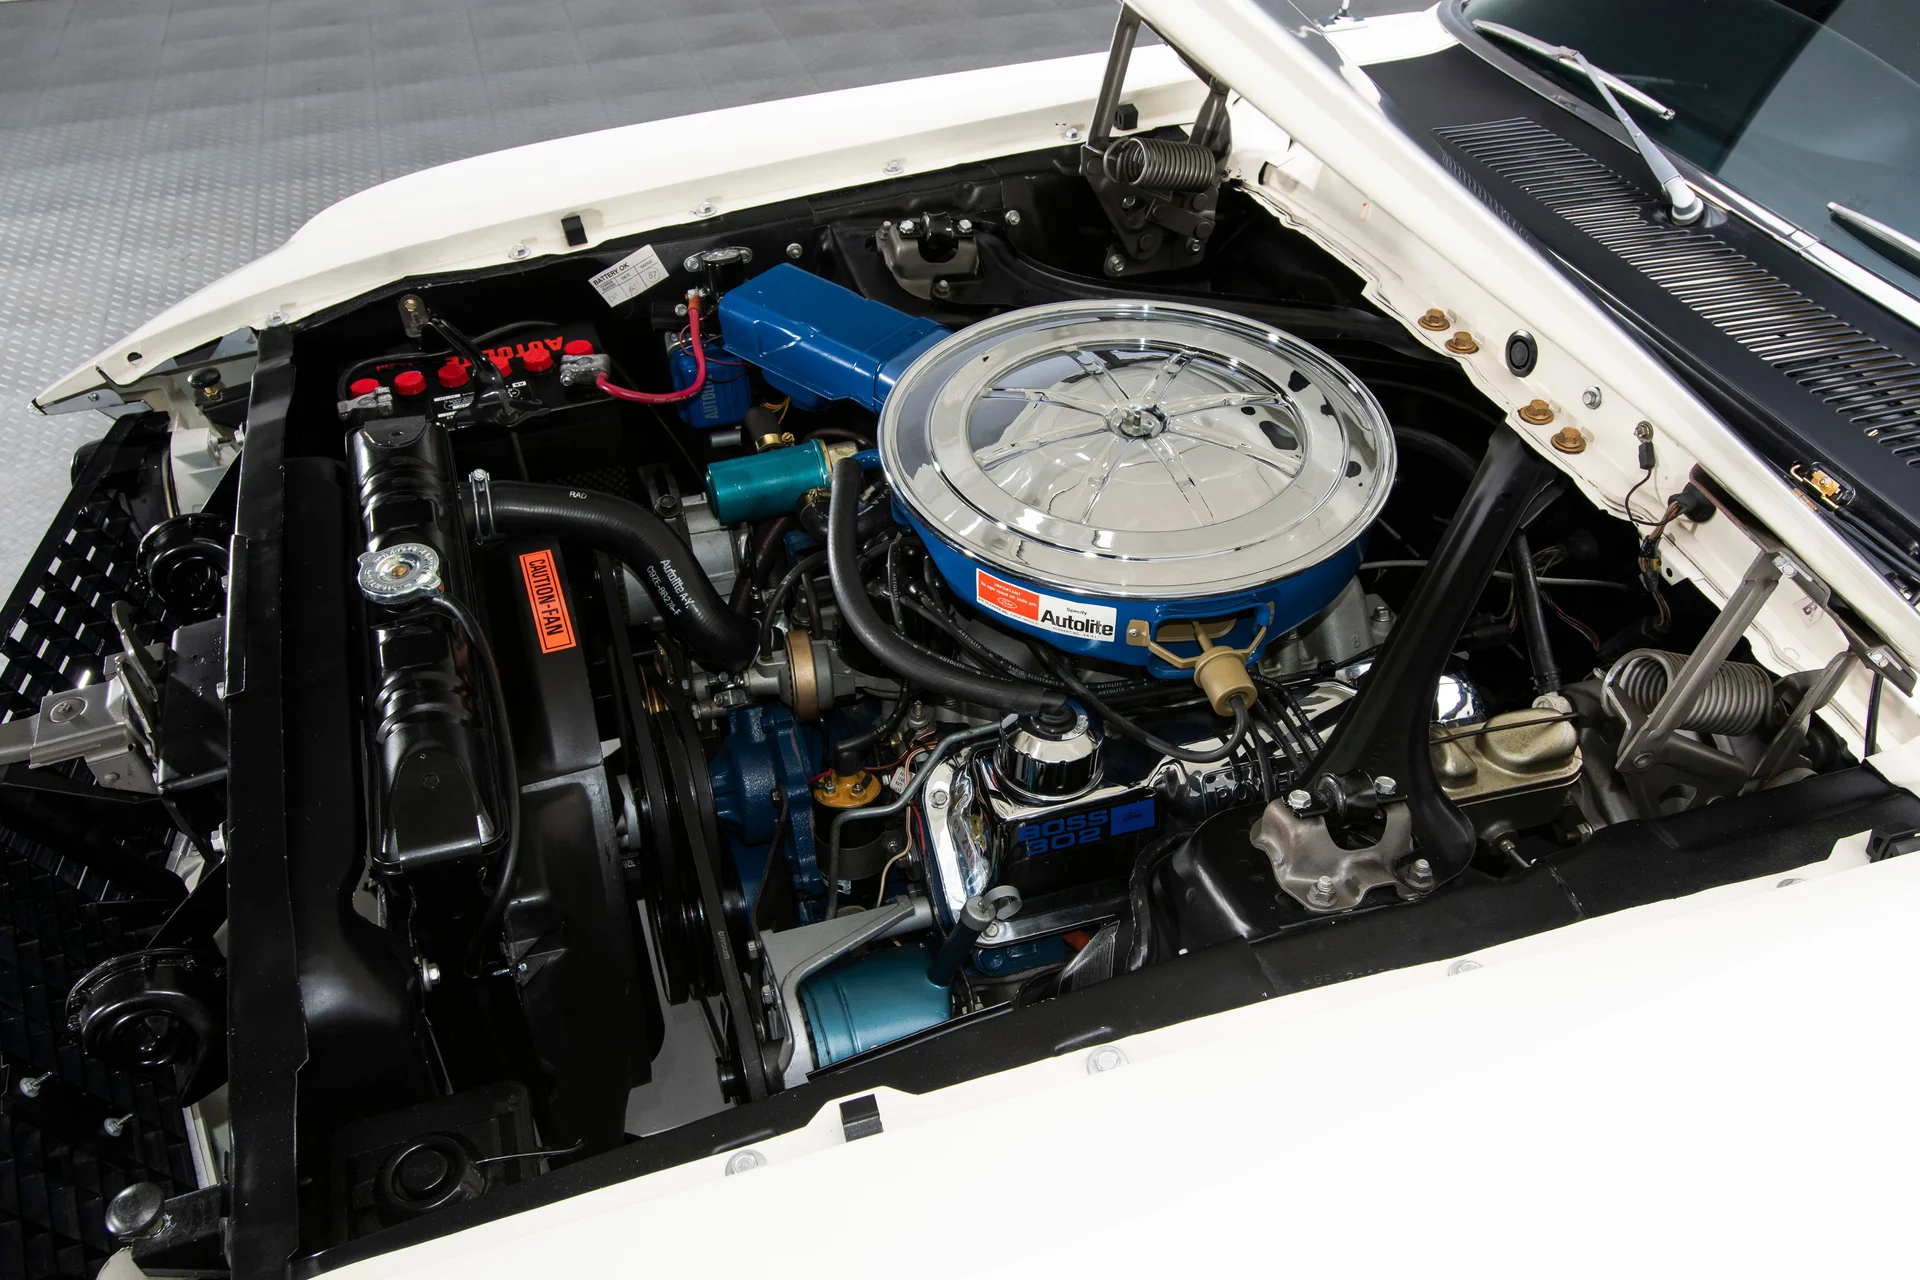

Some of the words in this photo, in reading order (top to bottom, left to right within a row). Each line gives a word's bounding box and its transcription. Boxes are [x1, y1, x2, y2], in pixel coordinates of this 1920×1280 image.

[592, 268, 619, 286] BATTERY
[620, 262, 630, 271] OK
[569, 490, 587, 499] RAD
[660, 559, 684, 594] Autolite
[529, 558, 564, 636] CAUTION-FAN
[993, 582, 1022, 596] IMPORTANT
[1040, 609, 1114, 637] Autolite
[1066, 607, 1087, 616] Specify
[958, 629, 982, 649] AUTOLITE
[939, 655, 965, 669] AUTOLITE
[1017, 809, 1108, 841] BOSS
[1025, 827, 1101, 856] 302
